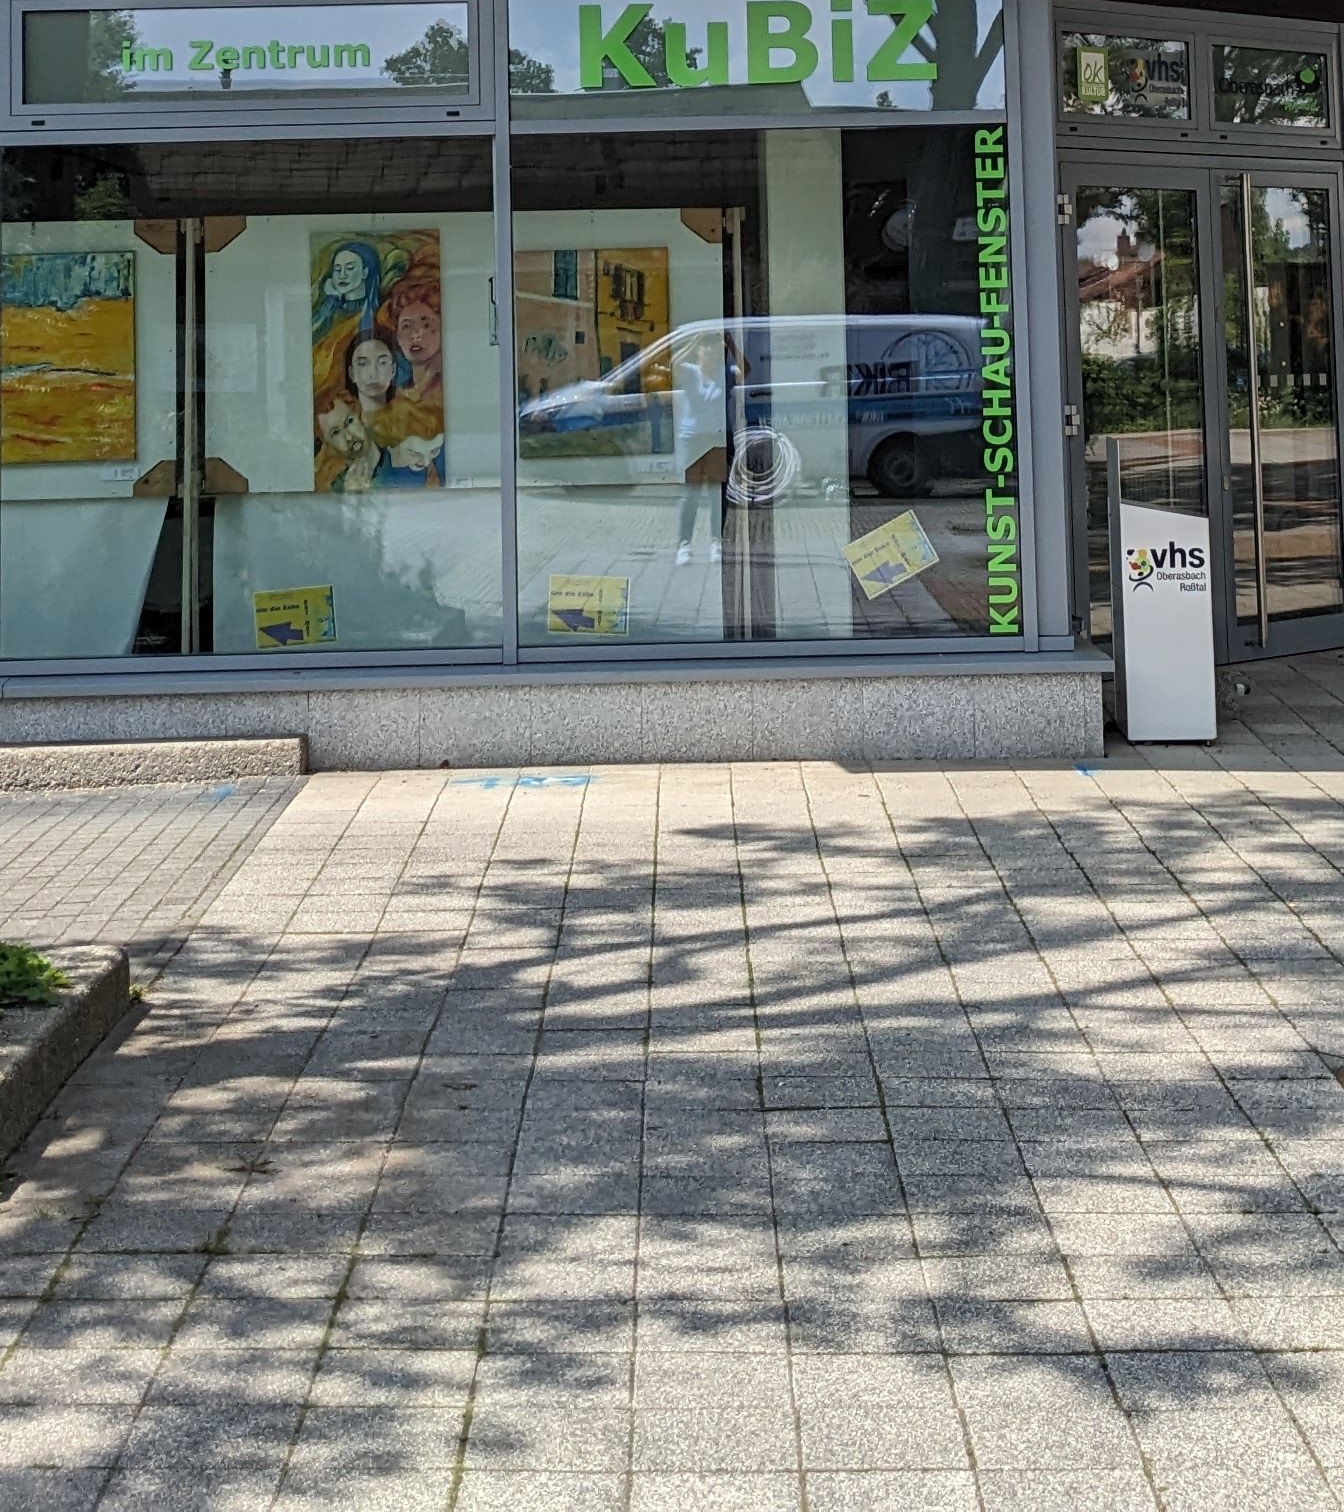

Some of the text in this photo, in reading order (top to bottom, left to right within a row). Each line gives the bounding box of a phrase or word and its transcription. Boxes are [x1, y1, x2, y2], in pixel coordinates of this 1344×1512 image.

[121, 39, 370, 72] im Zentrum
[1145, 52, 1181, 82] vhs
[975, 126, 1020, 634] KUNST-SCHAU-FENSTER
[1150, 541, 1205, 569] vhs
[1156, 571, 1206, 581] Oberasbach
